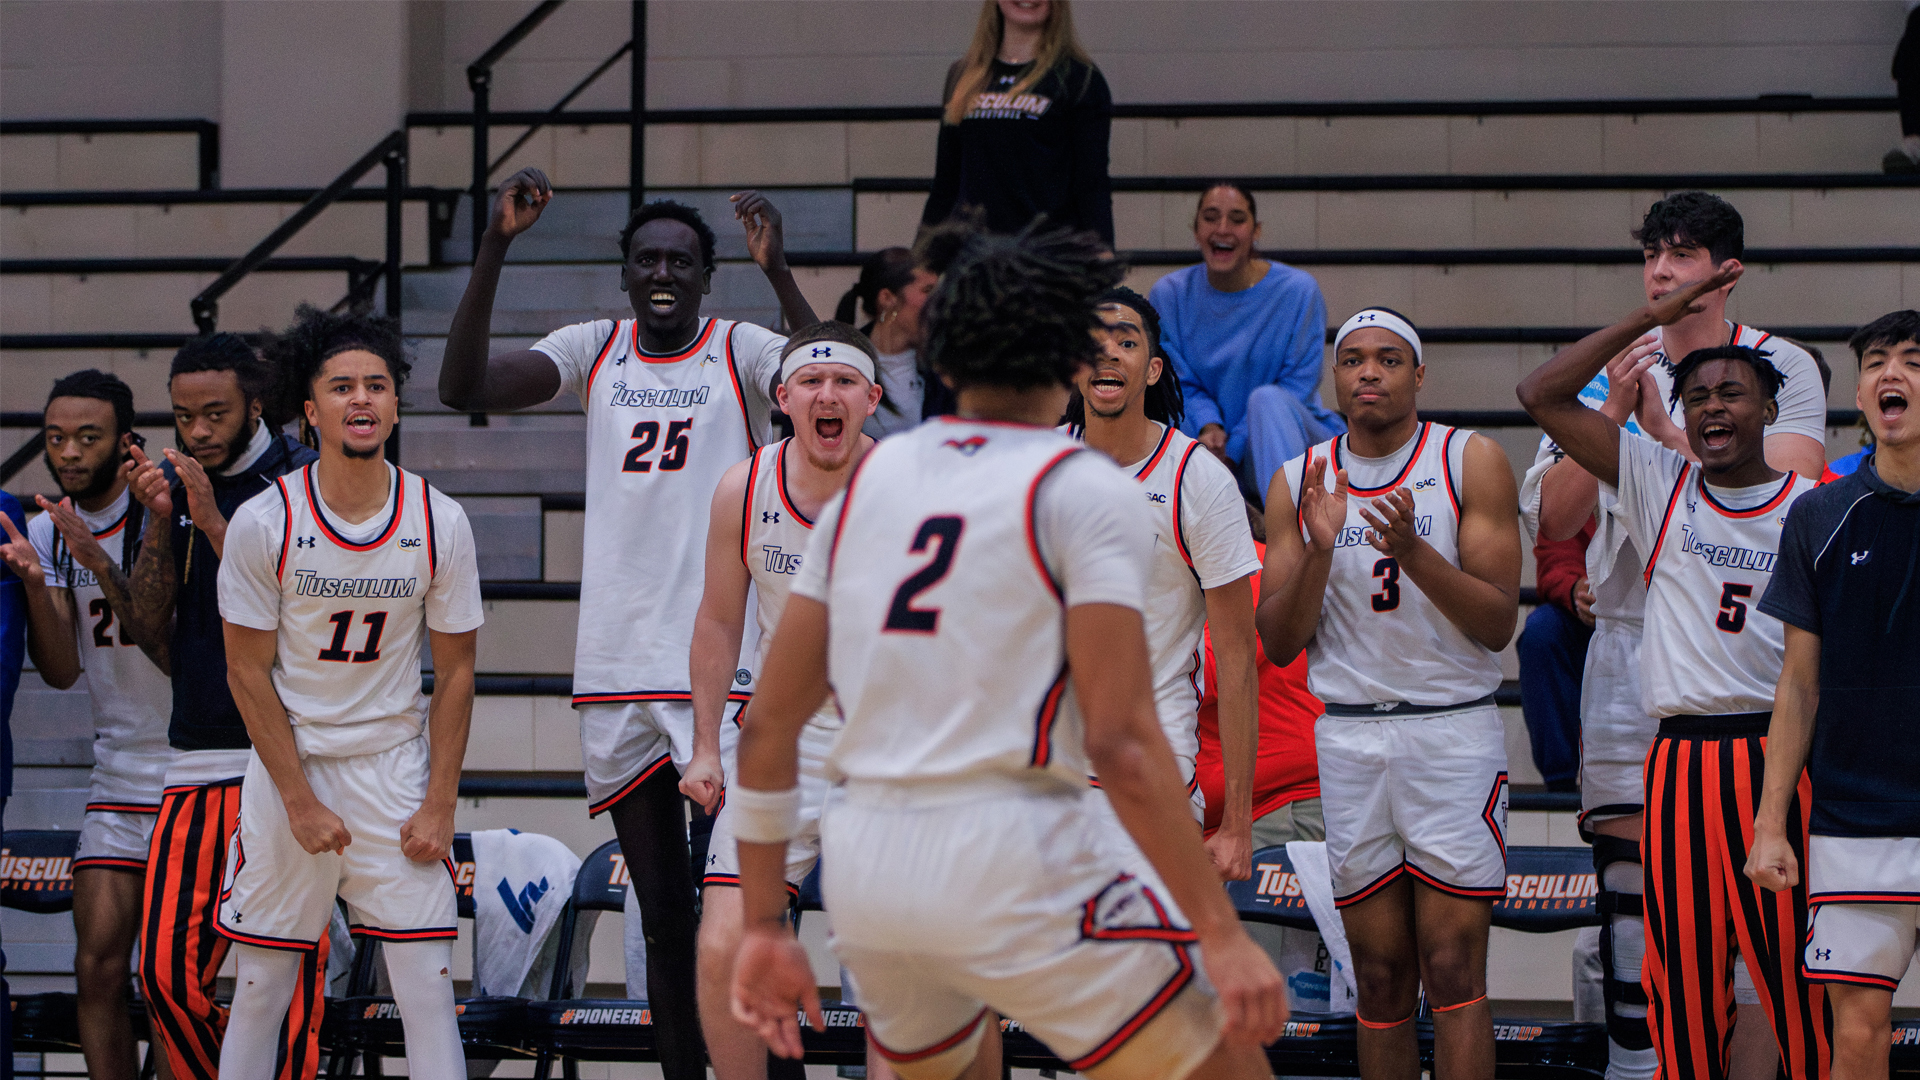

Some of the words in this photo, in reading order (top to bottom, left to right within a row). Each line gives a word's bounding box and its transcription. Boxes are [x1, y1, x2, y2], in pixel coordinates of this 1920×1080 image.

[702, 354, 718, 364] AC
[610, 381, 710, 408] TUSCULUM
[621, 417, 694, 473] 25
[1146, 491, 1167, 504] SAC
[1414, 478, 1436, 490] SAC
[400, 538, 421, 548] SAC
[295, 569, 417, 598] TUSCULUM
[879, 514, 966, 635] 2
[1371, 556, 1400, 613] 3
[1715, 582, 1754, 634] 5
[317, 610, 389, 664] 11
[1506, 874, 1599, 898] SCULUM
[560, 1008, 653, 1025] #PIONEERU
